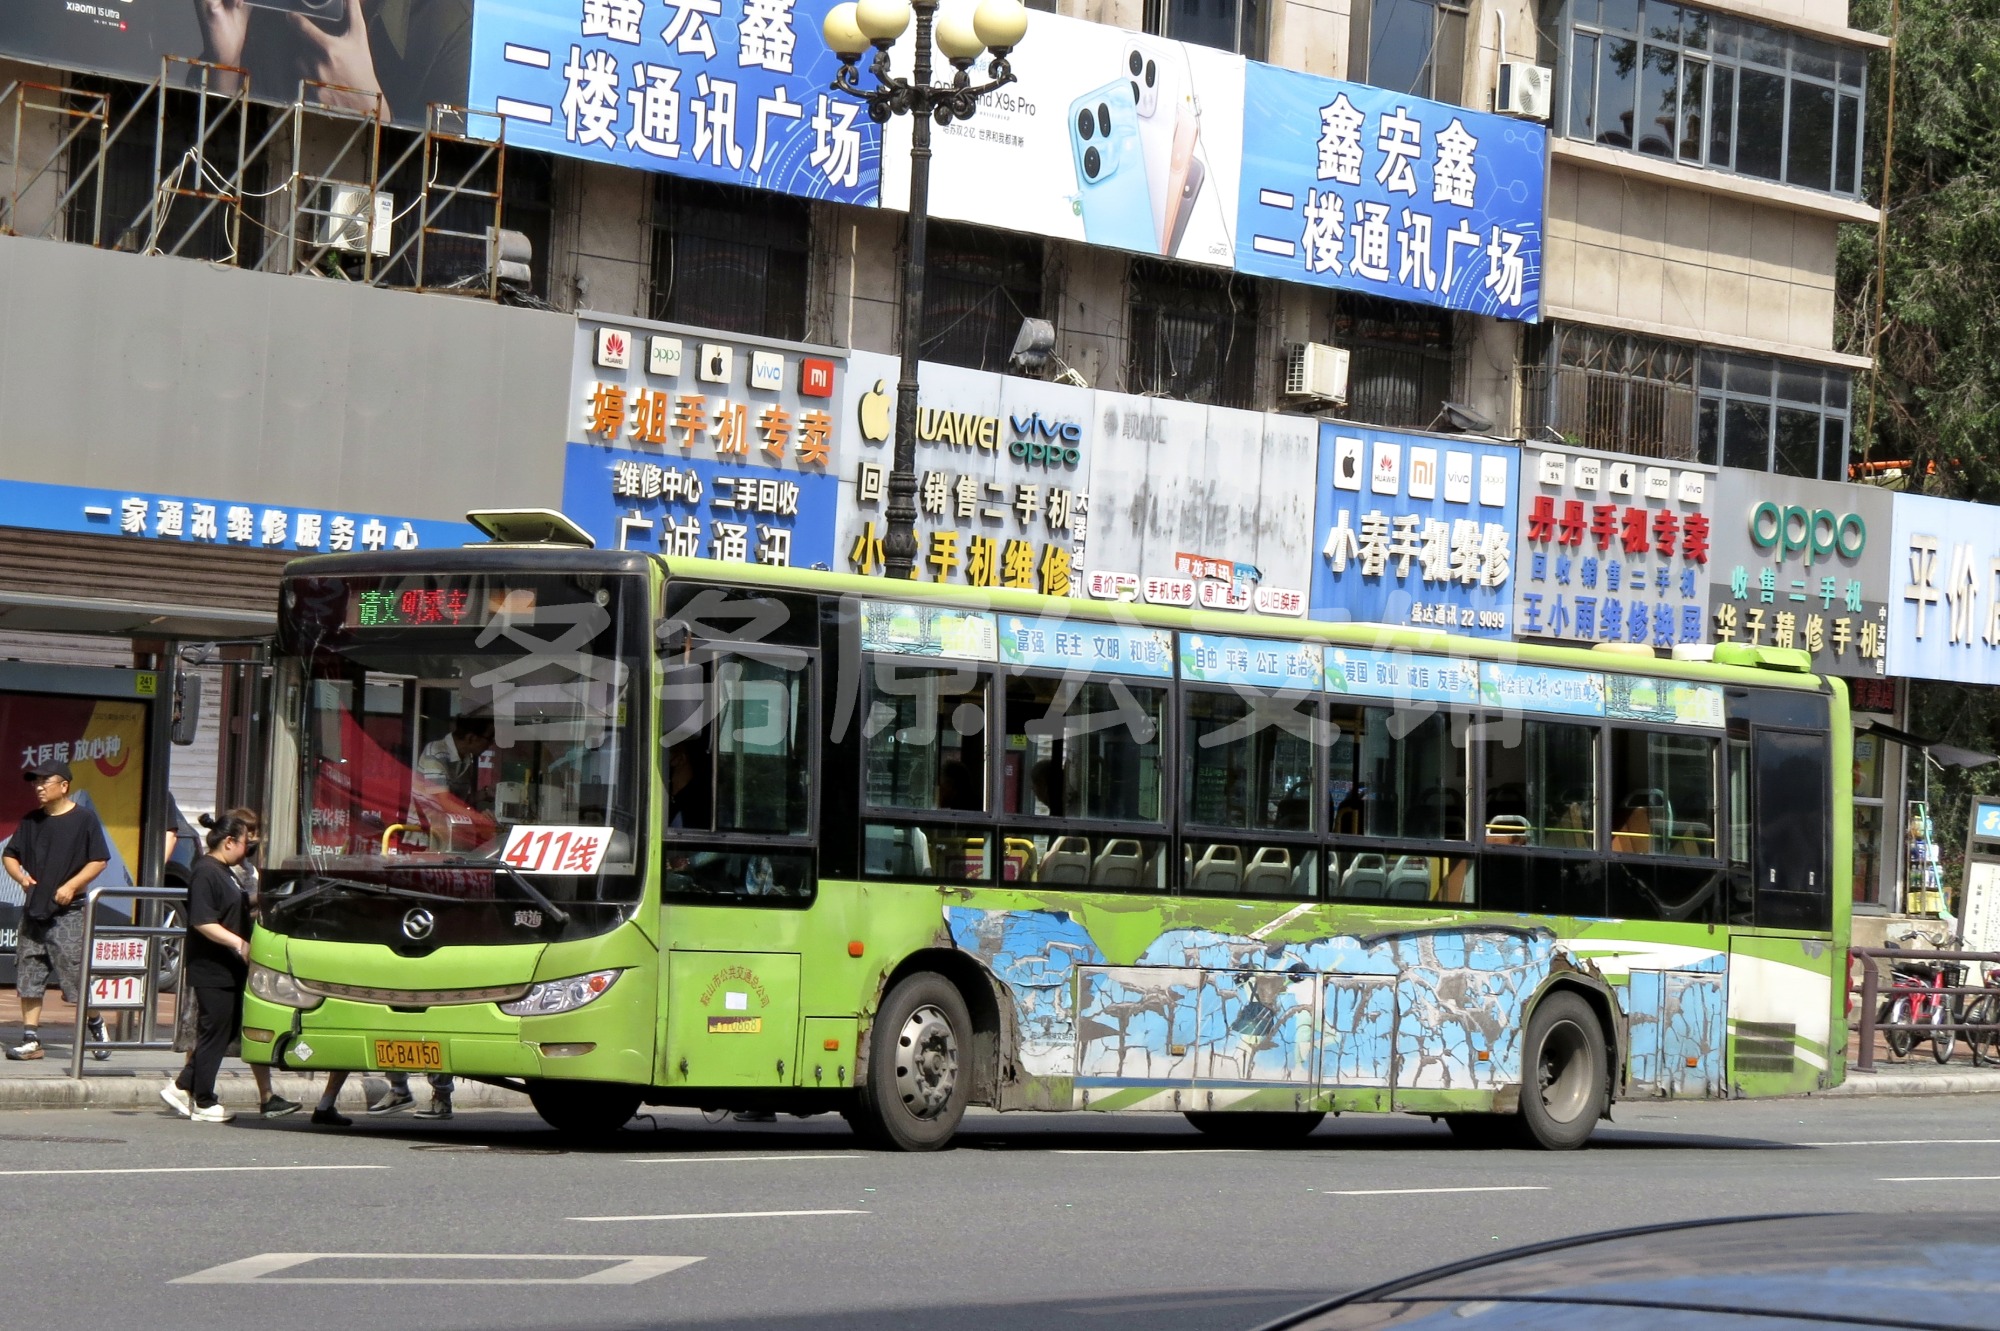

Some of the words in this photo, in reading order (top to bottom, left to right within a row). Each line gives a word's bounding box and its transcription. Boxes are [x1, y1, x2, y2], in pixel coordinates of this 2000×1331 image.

[496, 43, 863, 188] 二楼通讯广场
[995, 91, 1015, 112] X9s
[1018, 96, 1036, 116] Pro
[1316, 91, 1479, 208] 鑫宏鑫
[1253, 187, 1526, 307] 二楼通讯广场
[604, 357, 623, 365] HUAWEI
[756, 361, 781, 381] vivo
[586, 382, 832, 466] 婷姐手机专卖
[1011, 412, 1082, 441] vivo
[613, 461, 704, 503] 维修中心
[710, 475, 800, 516] 二手回收
[858, 460, 1073, 530] 回销售二手机
[1374, 474, 1397, 485] HUAWEI
[1447, 471, 1470, 484] vivo
[1685, 481, 1702, 494] vivo
[85, 497, 419, 551] 一家通讯维修服务中心
[616, 510, 792, 567] 广诚通讯
[1527, 495, 1710, 564] 丹丹手机专卖
[851, 521, 1071, 597] 小手机维修
[1069, 488, 1089, 599] 大器通讯
[1322, 509, 1511, 587] 小春手机维修
[1178, 557, 1232, 582] 翼龙通讯
[1530, 552, 1697, 598] 回收销售二手机
[1148, 580, 1192, 601] 手机快修
[1260, 591, 1301, 611] 以旧换新
[1730, 565, 1863, 613] 收售二手机
[1411, 601, 1457, 625] 盛达通讯
[1461, 609, 1474, 627] 22
[1479, 611, 1505, 628] 9099
[1716, 603, 1878, 659] 华子精修手机
[1016, 629, 1045, 654] 富强
[1055, 633, 1082, 657] 民主
[1092, 636, 1119, 660] 文明
[1130, 639, 1157, 664] 和谐
[1195, 647, 1218, 669] 自由
[1226, 649, 1249, 672] 平等
[1256, 652, 1279, 675] 公正
[1286, 654, 1309, 677] 法治
[1345, 661, 1368, 683] 爱国
[1376, 663, 1398, 685] 敬业
[1406, 666, 1429, 688] 诚信
[1437, 668, 1460, 691] 友善
[505, 831, 599, 872] 411线
[96, 942, 143, 961] 请您排队乘车
[95, 978, 133, 999] 411
